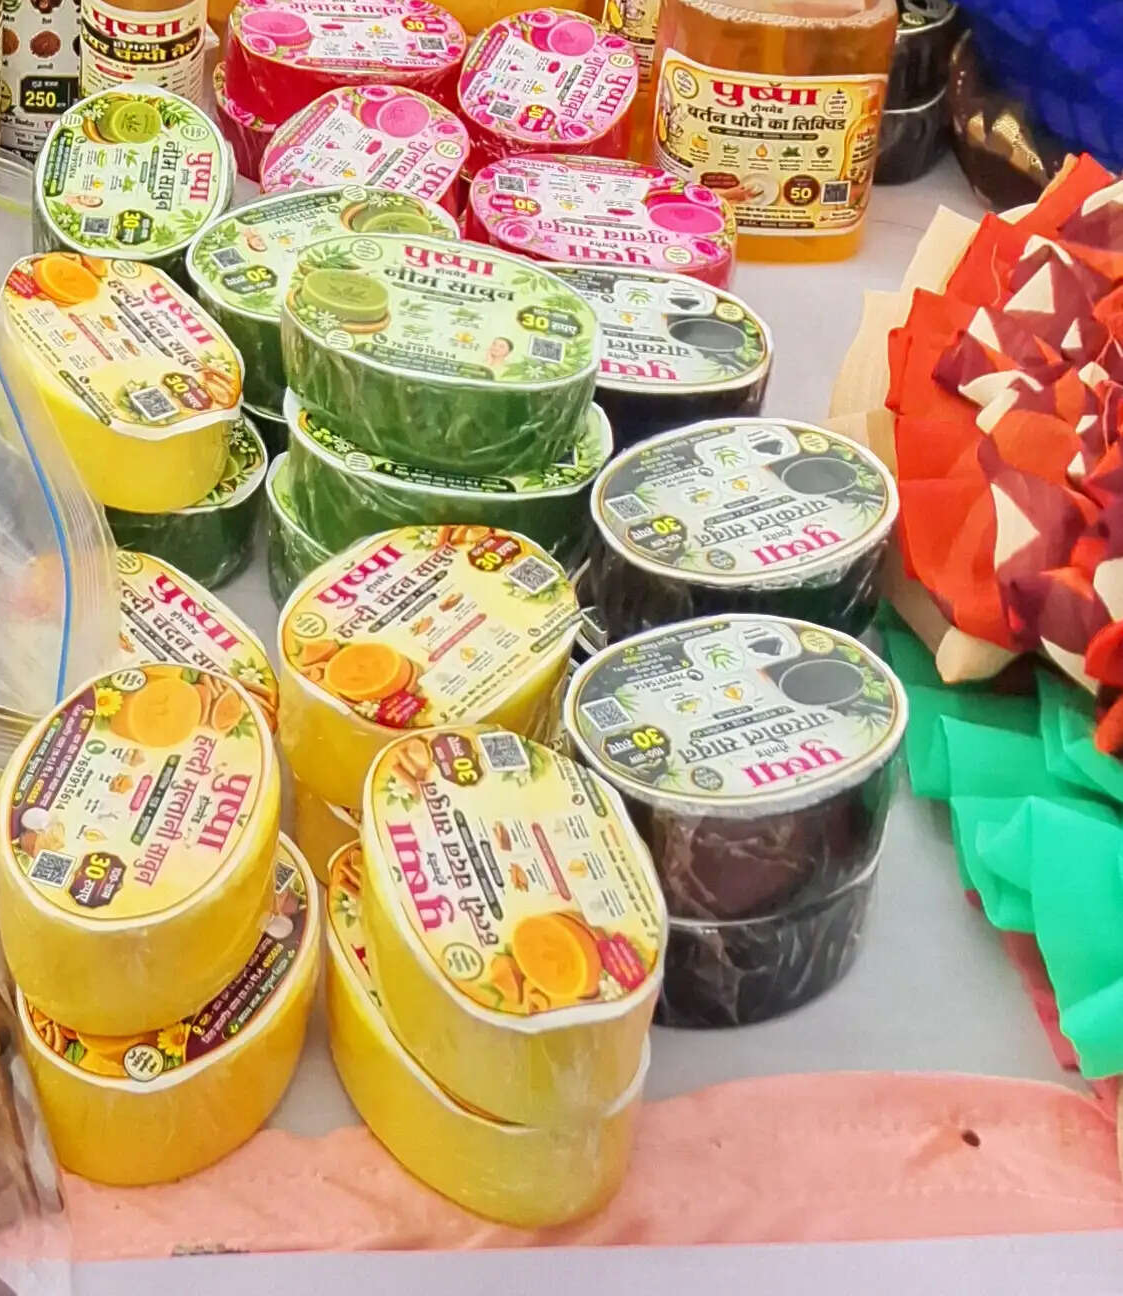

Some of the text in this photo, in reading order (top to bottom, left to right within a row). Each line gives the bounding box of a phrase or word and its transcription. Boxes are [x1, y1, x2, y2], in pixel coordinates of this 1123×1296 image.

[92, 7, 185, 37] पुष्पा
[25, 90, 56, 108] 250
[710, 79, 822, 108] पुष्पा
[731, 112, 764, 130] धोने
[768, 117, 788, 130] का
[186, 150, 213, 203] पुष्पा
[790, 187, 813, 200] 50
[403, 244, 495, 276] पुष्पा
[144, 281, 216, 345] पुष्पा
[521, 312, 549, 330] 30
[167, 374, 187, 393] 30
[651, 517, 681, 536] 30
[750, 523, 846, 567] पुष्पा
[476, 551, 503, 571] 30
[315, 543, 406, 610] पुष्पा
[148, 571, 243, 652] पुष्पा
[632, 726, 665, 749] 30
[185, 734, 218, 777] हल्दी
[740, 737, 848, 789] पुष्पा
[453, 758, 477, 784] 30
[197, 770, 254, 853] पुष्पा
[84, 853, 111, 881] 30
[384, 820, 456, 933] पुष्पा
[458, 893, 501, 949] हल्दी
